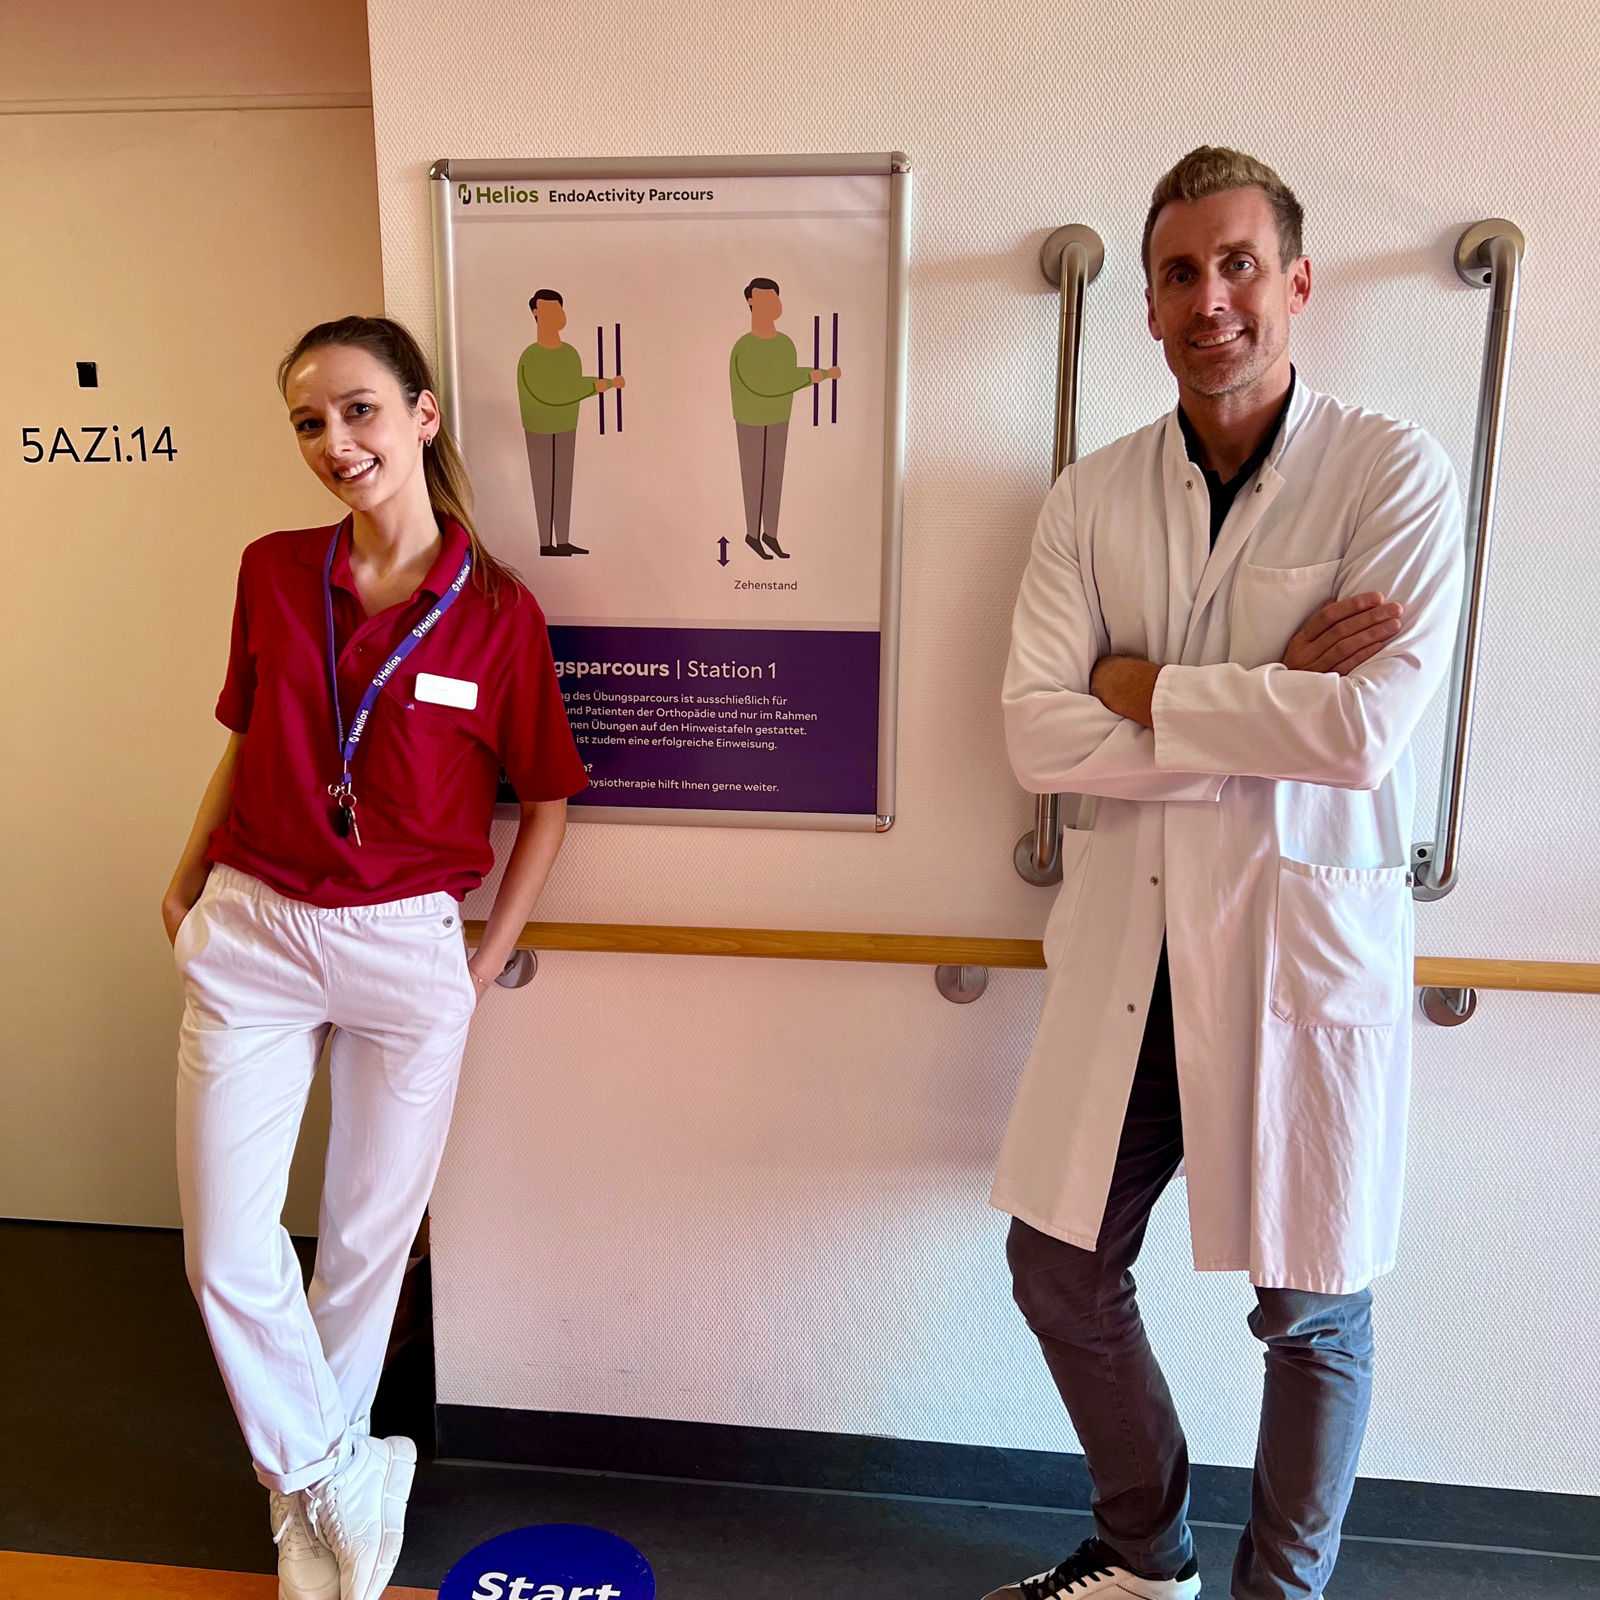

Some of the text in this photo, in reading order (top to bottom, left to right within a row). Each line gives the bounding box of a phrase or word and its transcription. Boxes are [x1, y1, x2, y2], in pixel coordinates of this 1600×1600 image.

[476, 186, 714, 204] Helios EndoActivity Parcours
[22, 425, 178, 463] 5AZi.14
[456, 564, 471, 588] Helios
[734, 580, 798, 590] Zehenstand
[418, 608, 442, 633] Helios
[377, 655, 402, 681] Helios
[687, 660, 763, 679] Station
[768, 662, 777, 679] 1
[573, 691, 591, 700] des
[593, 689, 679, 703] Übungsparcours
[681, 693, 694, 703] ist
[696, 695, 770, 705] ausschließlich
[772, 696, 788, 705] für
[352, 709, 369, 736] Helios
[585, 707, 636, 717] Patienten
[637, 707, 653, 716] der
[656, 708, 716, 719] Orthopädie
[718, 710, 738, 718] und
[760, 711, 773, 719] im
[775, 711, 817, 721] Rahmen
[591, 719, 638, 732] Übungen
[641, 722, 657, 731] auf
[659, 722, 679, 732] den
[681, 723, 753, 734] Hinweistafeln
[755, 724, 807, 736] gestattet.
[576, 735, 777, 750] ist zudem eine erfolgreiche Einweisung.
[658, 779, 679, 789] hilft
[682, 780, 710, 790] Ihnen
[712, 783, 742, 792] gerne
[744, 782, 779, 792] weiter.
